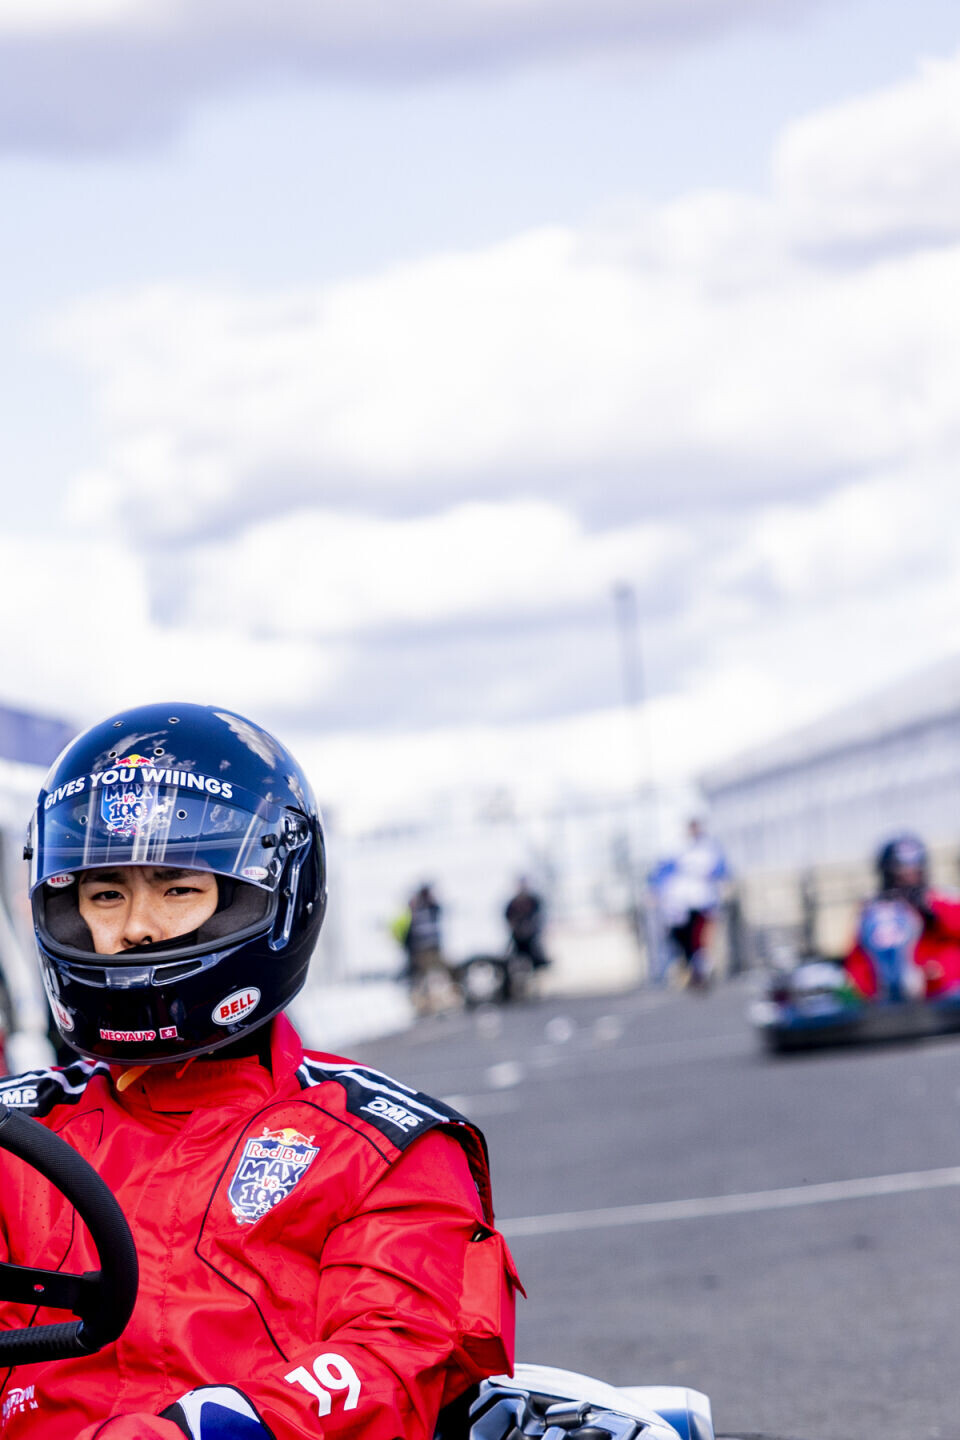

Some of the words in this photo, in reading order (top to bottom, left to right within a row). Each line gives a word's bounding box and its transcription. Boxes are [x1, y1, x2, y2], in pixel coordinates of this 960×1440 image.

[44, 776, 86, 810] GIVES
[90, 768, 136, 787] YOU
[141, 768, 233, 799] WIIINGS
[109, 803, 147, 820] 100
[50, 875, 71, 884] BELL
[220, 993, 256, 1019] BELL
[367, 1100, 419, 1127] OMP
[248, 1142, 282, 1158] Red
[282, 1147, 315, 1164] Bull
[240, 1160, 306, 1186] MAX
[240, 1183, 288, 1207] 100
[284, 1353, 361, 1417] 19
